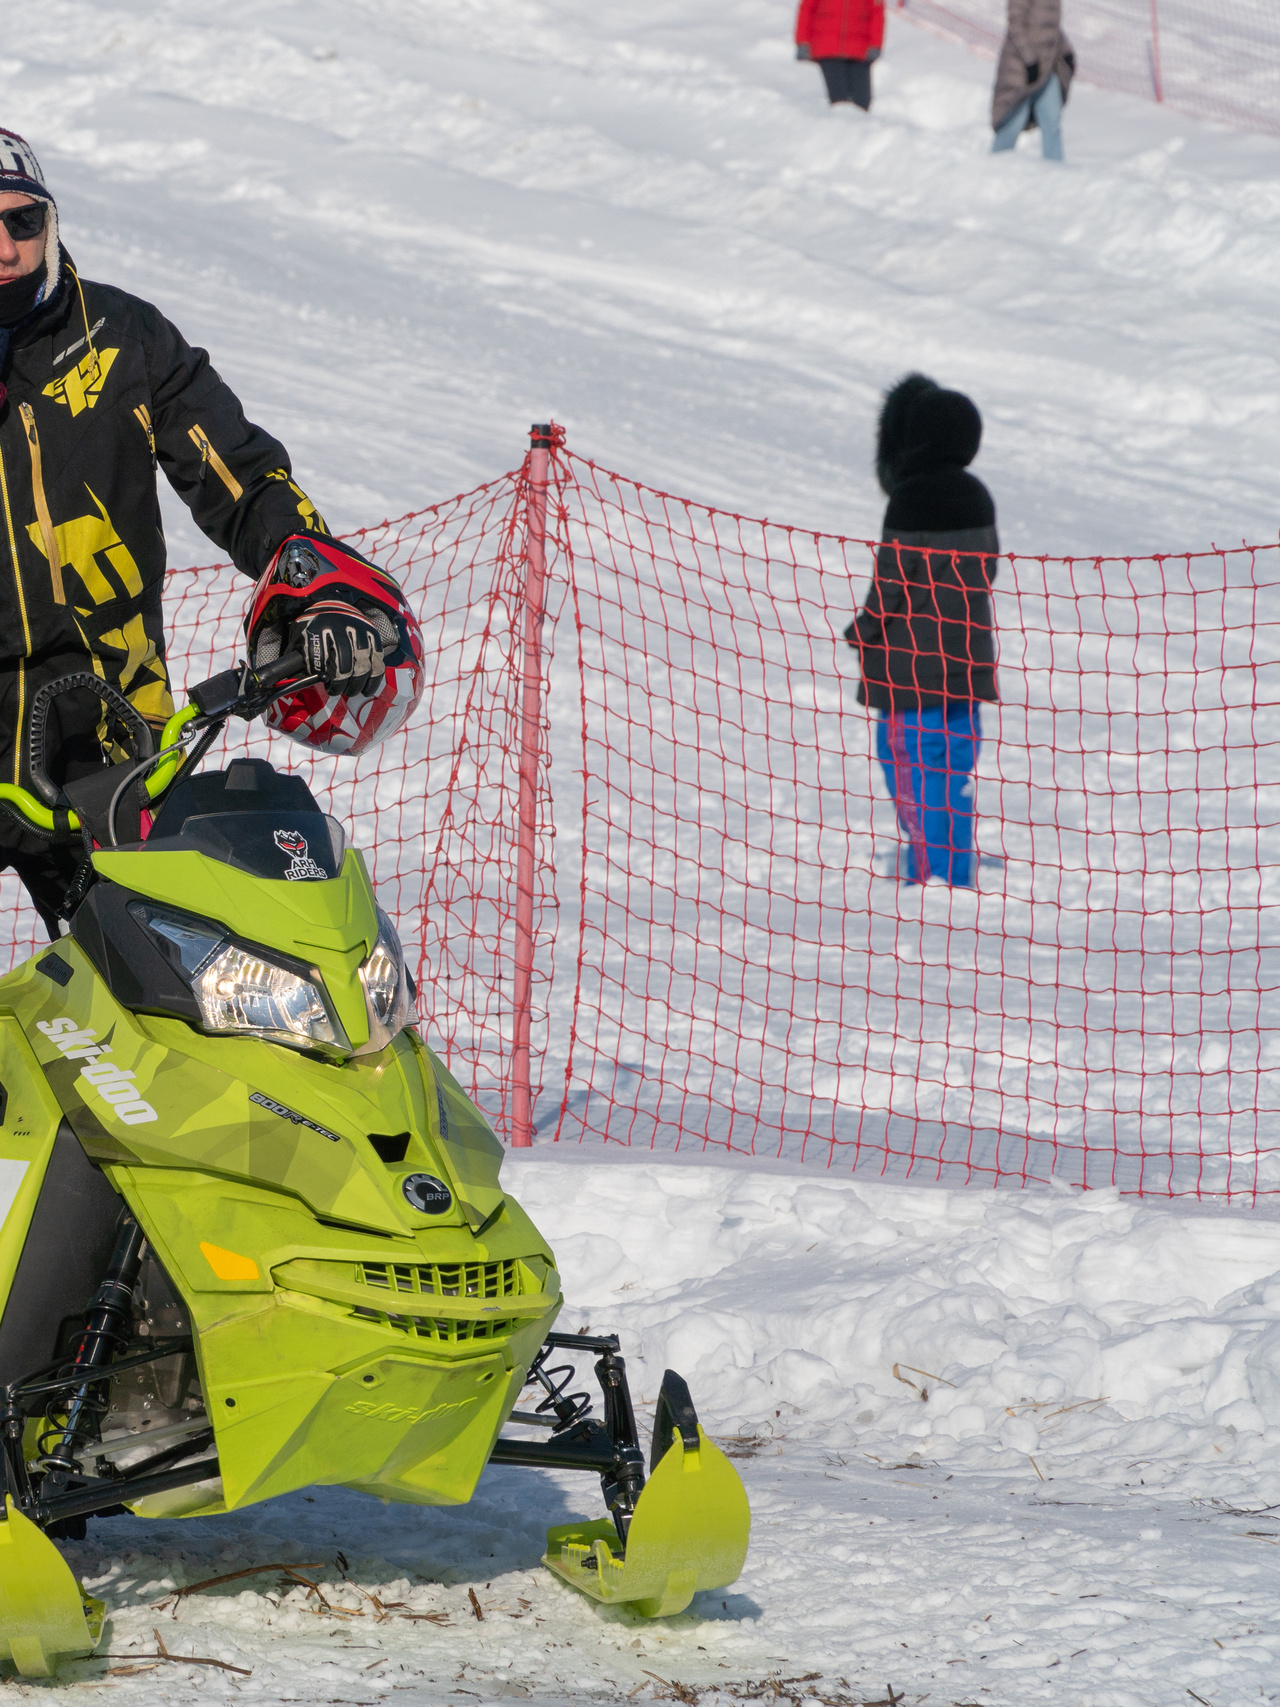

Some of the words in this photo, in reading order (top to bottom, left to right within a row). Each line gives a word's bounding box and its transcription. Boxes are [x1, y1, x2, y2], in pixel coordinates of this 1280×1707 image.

[310, 634, 322, 672] reusch
[293, 859, 316, 869] ARH
[286, 868, 327, 879] RIDERS
[36, 1017, 158, 1126] ski-doo
[426, 1193, 450, 1201] BRP
